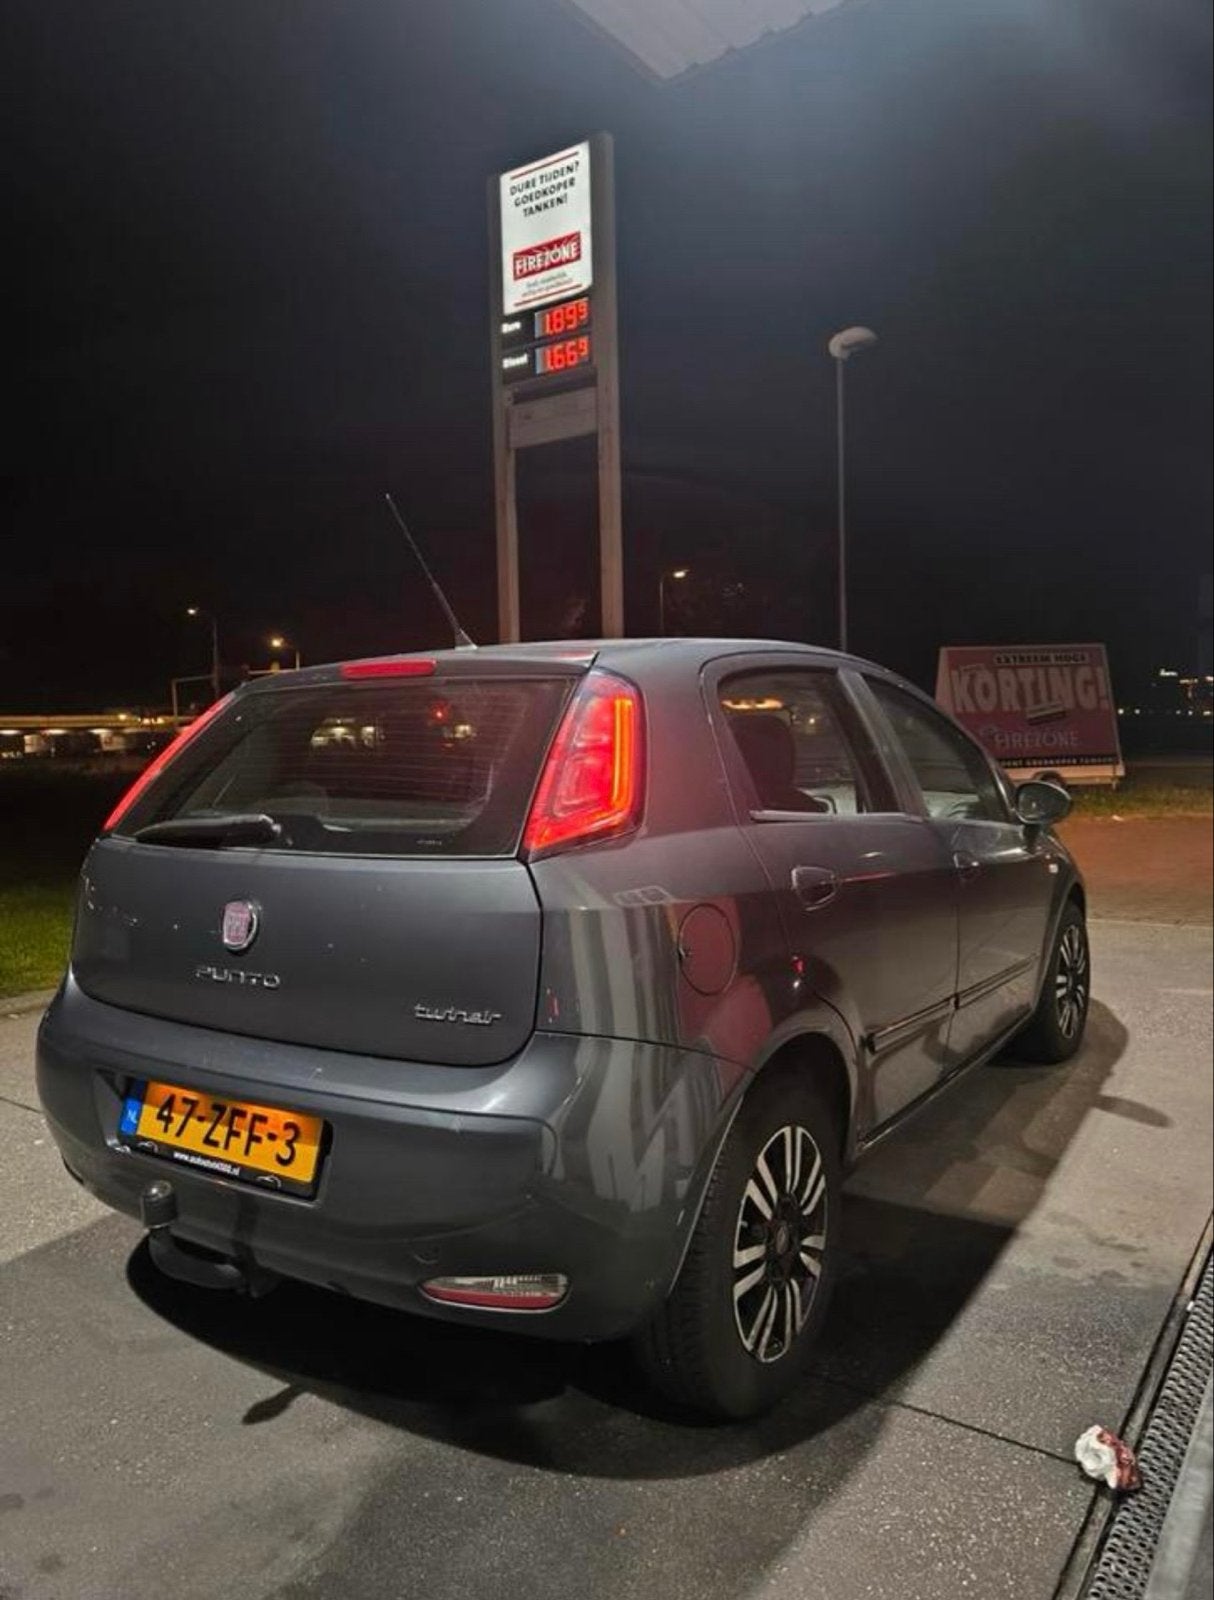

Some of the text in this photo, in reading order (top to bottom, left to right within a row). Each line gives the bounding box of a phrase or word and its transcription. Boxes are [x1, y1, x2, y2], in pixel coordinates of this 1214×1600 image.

[510, 161, 579, 195] DURE TIJDEN?
[514, 177, 576, 207] GOEDKOPER
[523, 193, 568, 217] TANKEN!
[514, 240, 579, 276] FIREZONE
[951, 666, 1111, 713] KORTING!
[196, 966, 281, 989] PUNTO
[156, 1093, 301, 1167] 47-ZFF-3
